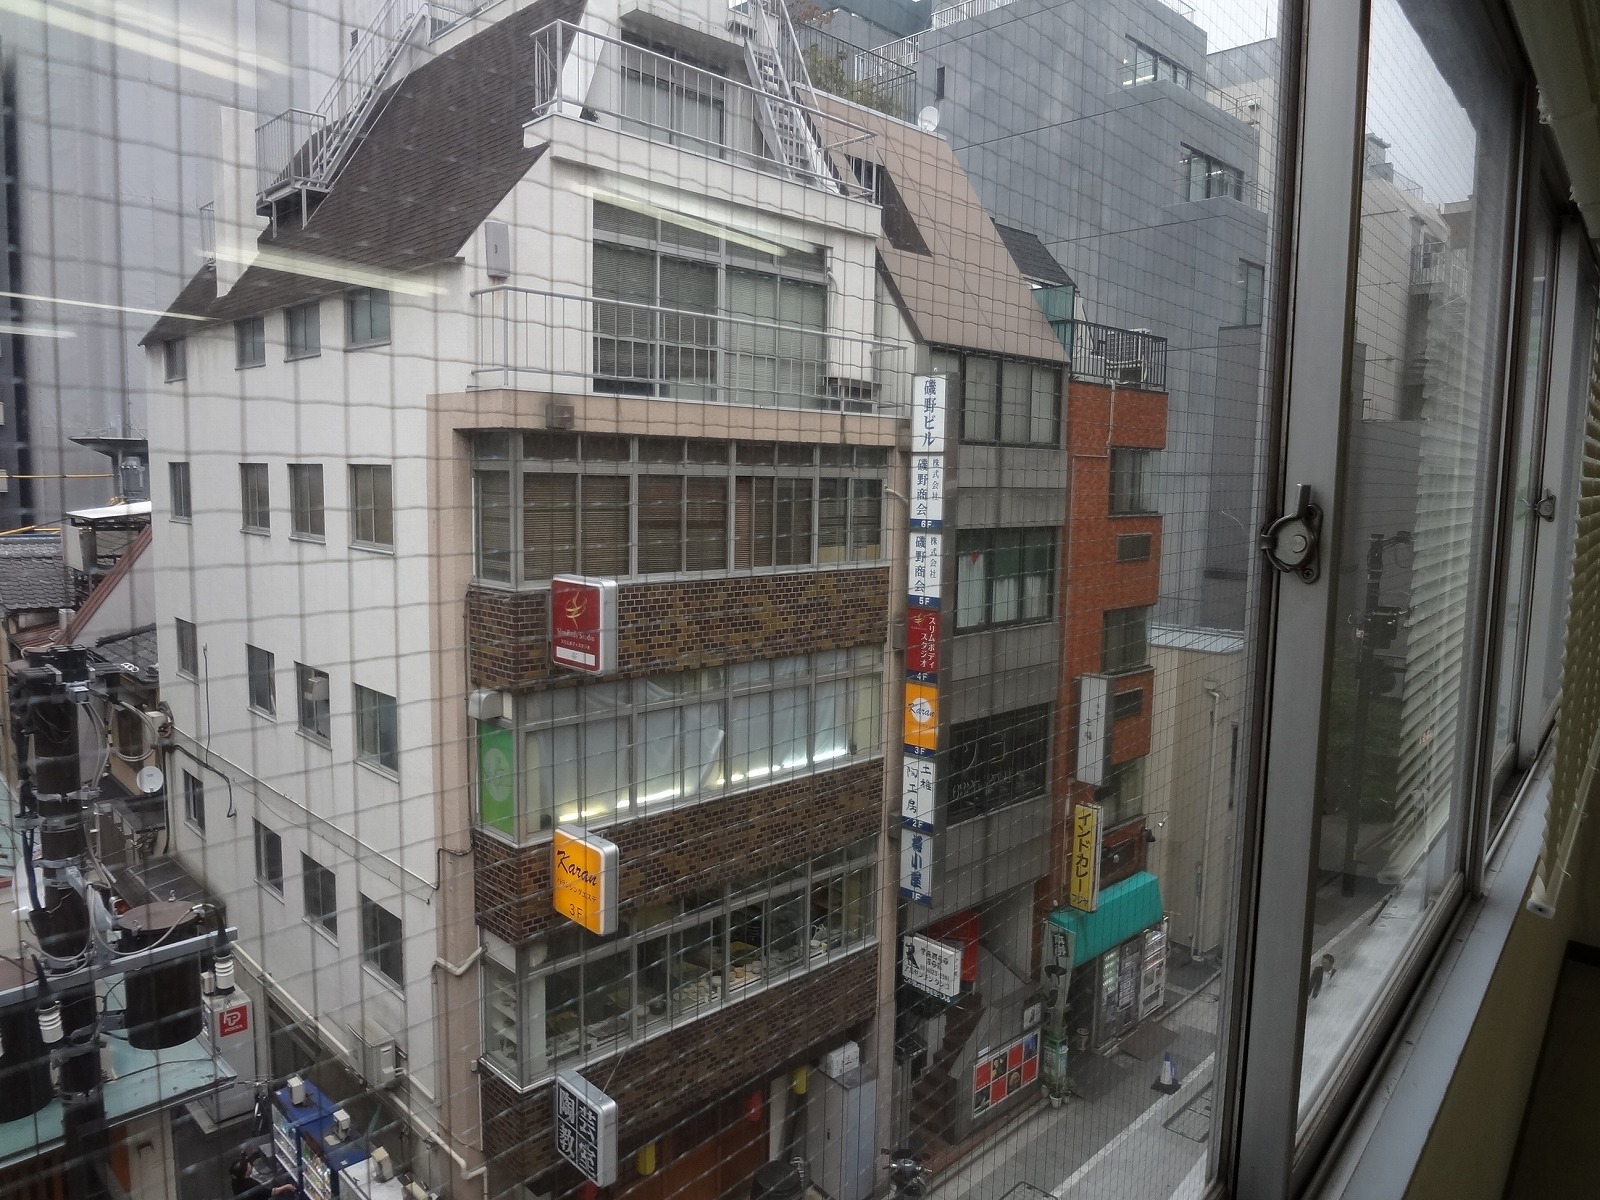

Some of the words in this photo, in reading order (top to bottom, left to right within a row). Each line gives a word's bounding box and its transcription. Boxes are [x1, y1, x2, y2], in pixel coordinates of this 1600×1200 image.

[922, 378, 937, 448] 磯野ビル
[916, 458, 928, 516] 磯野商会
[931, 458, 940, 501] 株式会社
[920, 519, 932, 529] 6F
[914, 535, 926, 593] 磯野商会
[929, 536, 938, 579] 株式会社
[918, 596, 930, 606] 5F
[919, 632, 928, 668] スタジオ
[927, 616, 936, 669] スリムボディ
[916, 672, 928, 681] 4F
[907, 702, 935, 717] Karan
[914, 746, 926, 755] 3F
[912, 819, 923, 829] 2F
[556, 849, 598, 887] Karan
[1075, 812, 1092, 893] インドカレー
[569, 903, 583, 919] 3F
[911, 891, 922, 901] 1F
